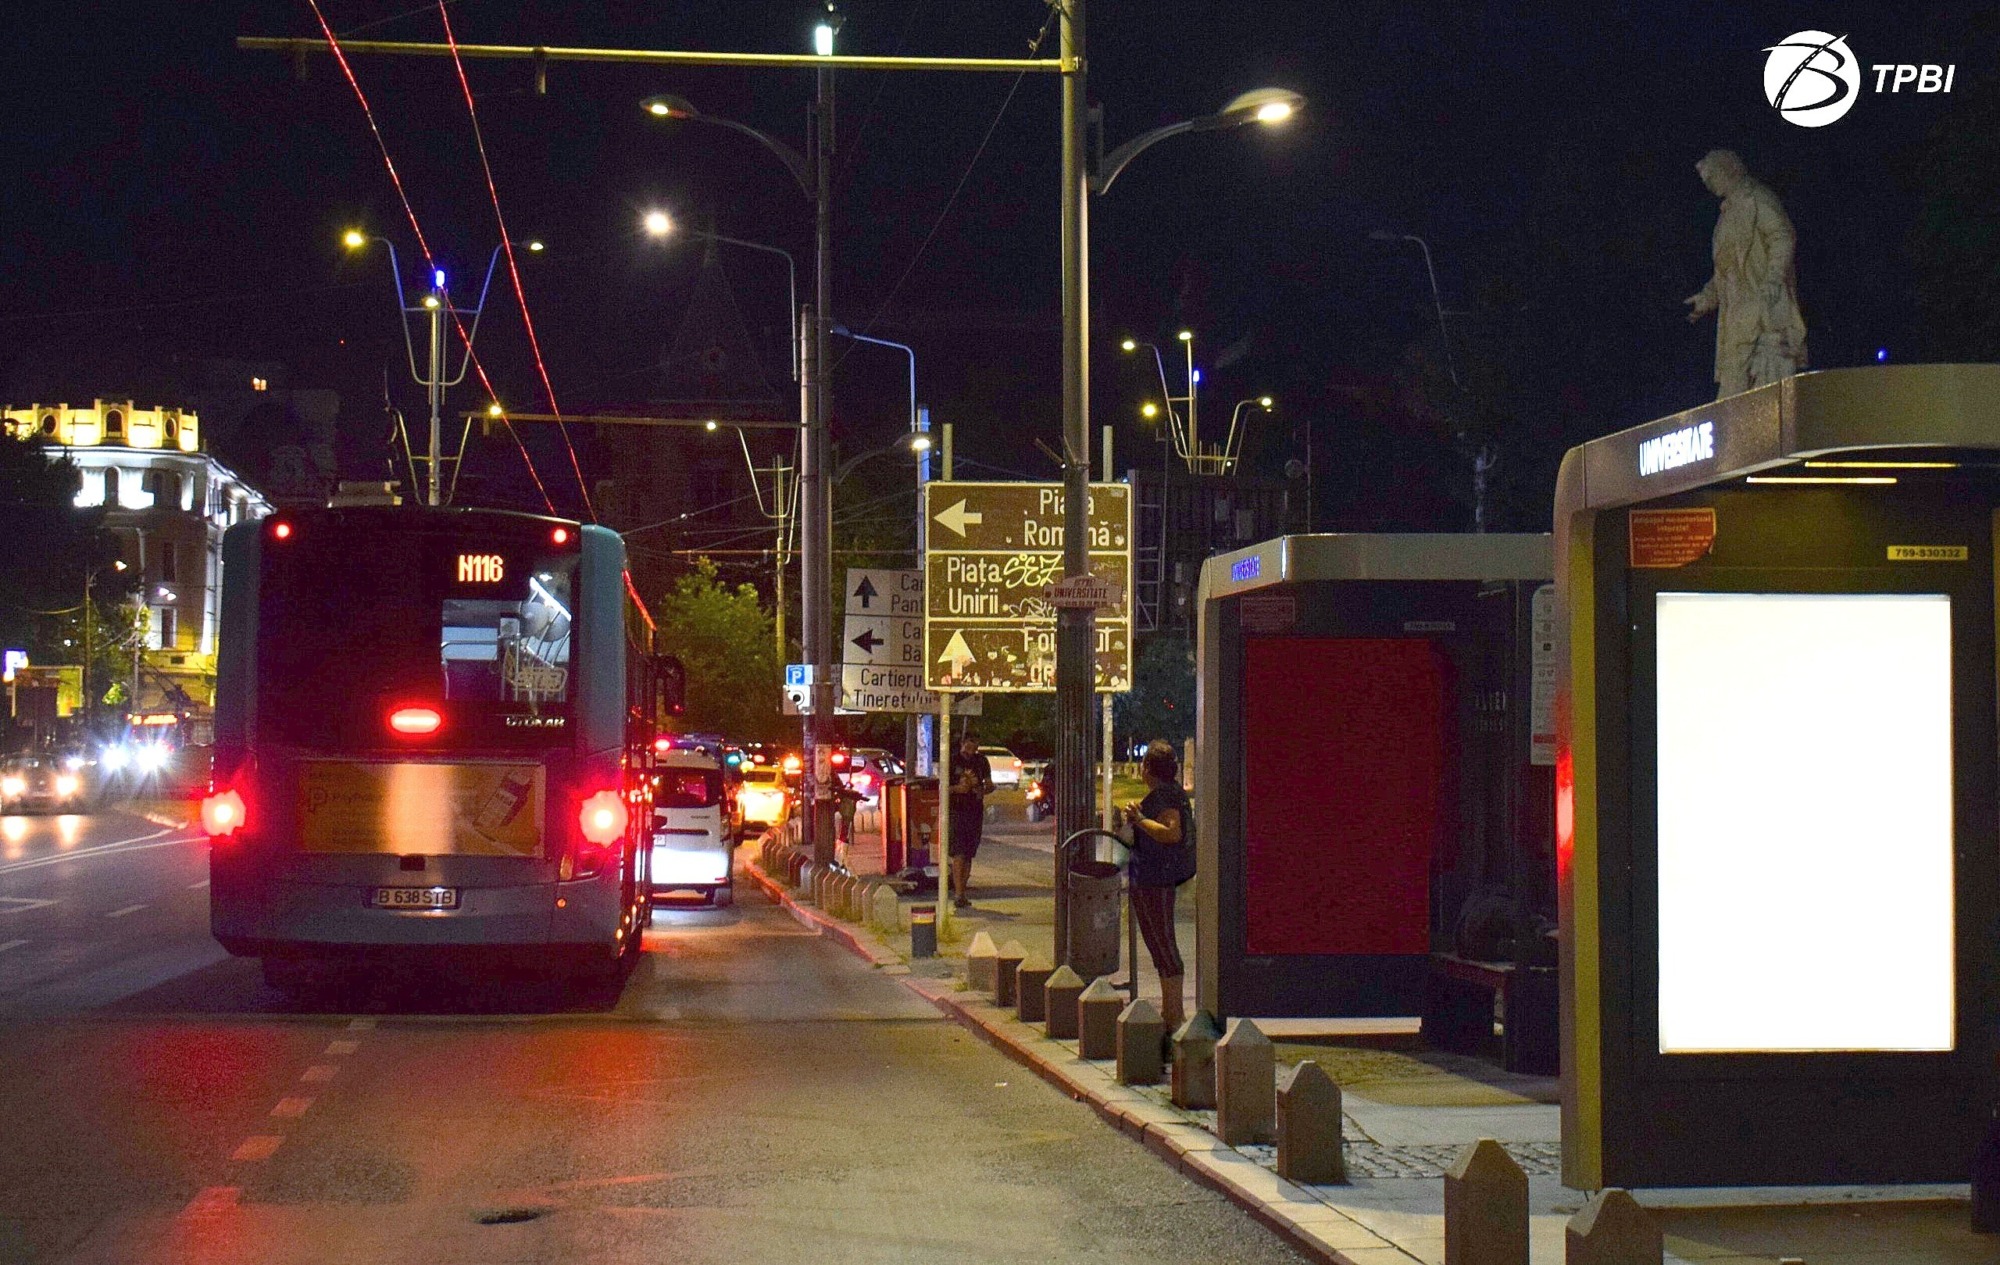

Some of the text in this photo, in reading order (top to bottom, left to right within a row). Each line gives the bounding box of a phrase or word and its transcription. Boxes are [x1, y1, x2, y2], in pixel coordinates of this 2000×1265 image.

[1024, 520, 1110, 546] Romnă
[459, 555, 503, 582] N116
[947, 556, 1003, 589] Piața
[949, 588, 999, 614] Unirii
[1054, 588, 1107, 599] UNIVERSITATE
[1024, 626, 1110, 652] Foiul
[861, 668, 923, 688] Cartieru
[379, 891, 453, 904] B 638 STB
